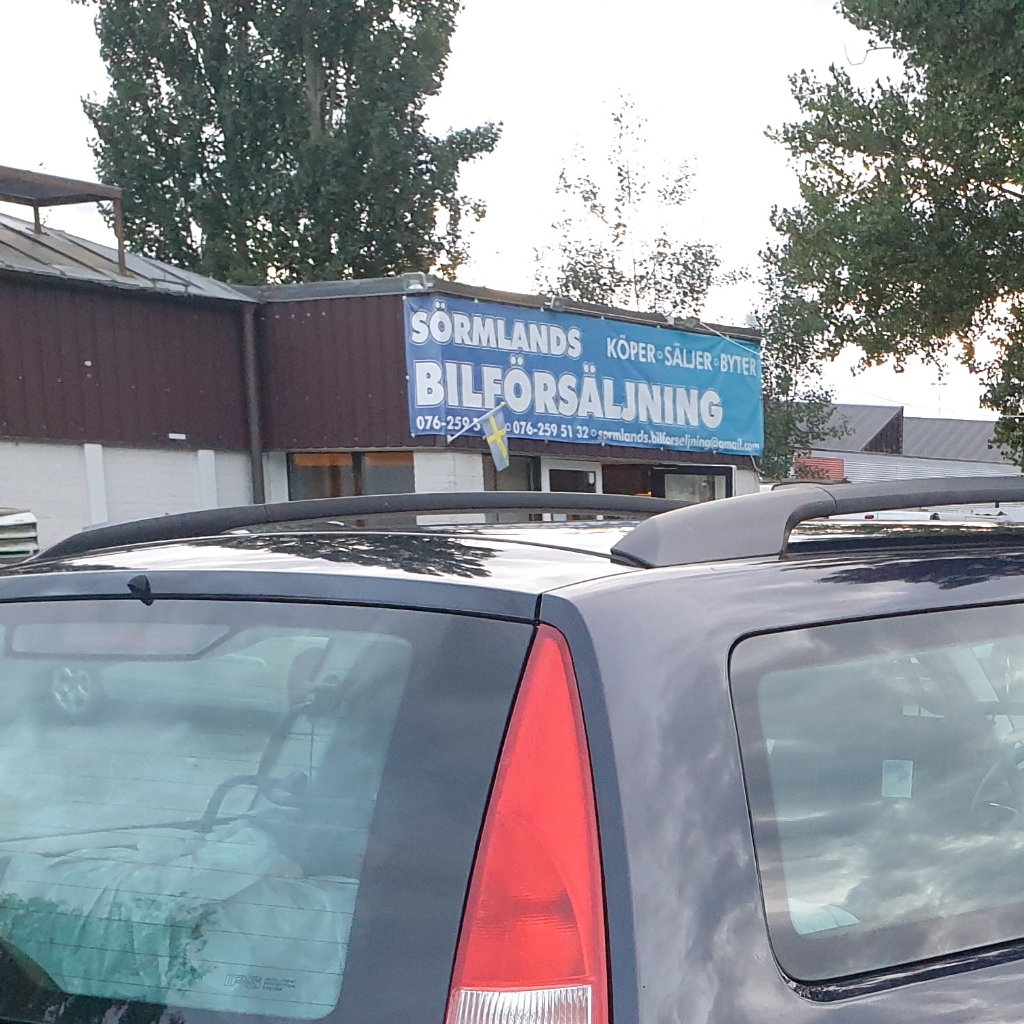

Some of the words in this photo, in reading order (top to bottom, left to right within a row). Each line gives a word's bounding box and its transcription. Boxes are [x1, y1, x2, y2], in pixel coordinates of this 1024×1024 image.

[411, 299, 582, 359] SÖRMLANDS
[606, 334, 657, 363] KÖPER
[664, 342, 712, 370] SÄLJER
[720, 353, 757, 377] BYTER
[414, 354, 723, 429] BILFÖRSÄLJNING
[416, 415, 470, 430] 076-259
[513, 420, 557, 436] 076-259
[561, 424, 573, 438] 51
[576, 425, 589, 439] 32
